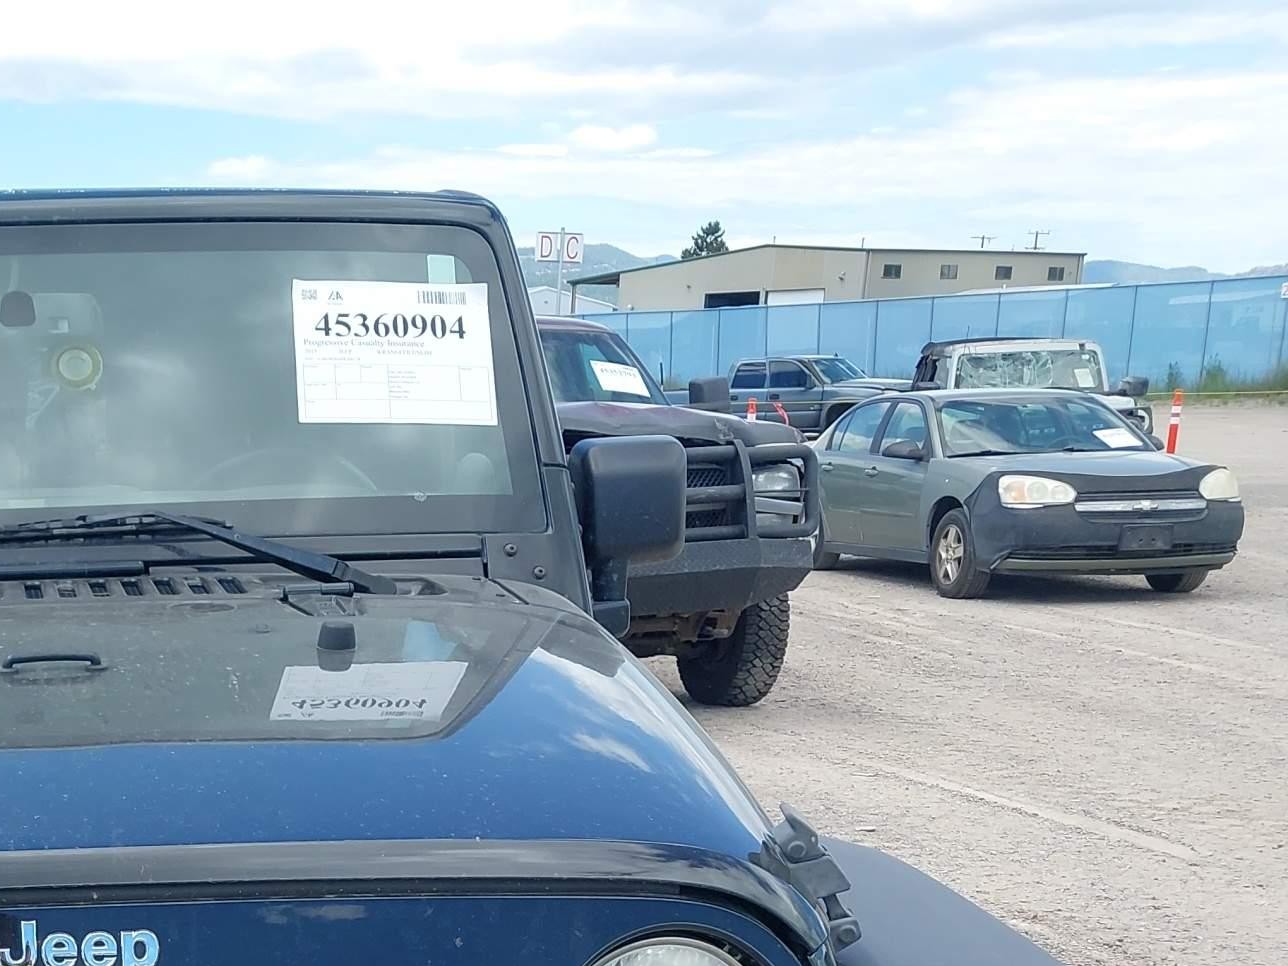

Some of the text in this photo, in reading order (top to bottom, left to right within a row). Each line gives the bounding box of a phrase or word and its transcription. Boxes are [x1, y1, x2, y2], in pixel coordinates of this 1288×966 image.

[540, 235, 553, 258] D
[566, 236, 579, 259] C
[314, 312, 467, 340] 45360904
